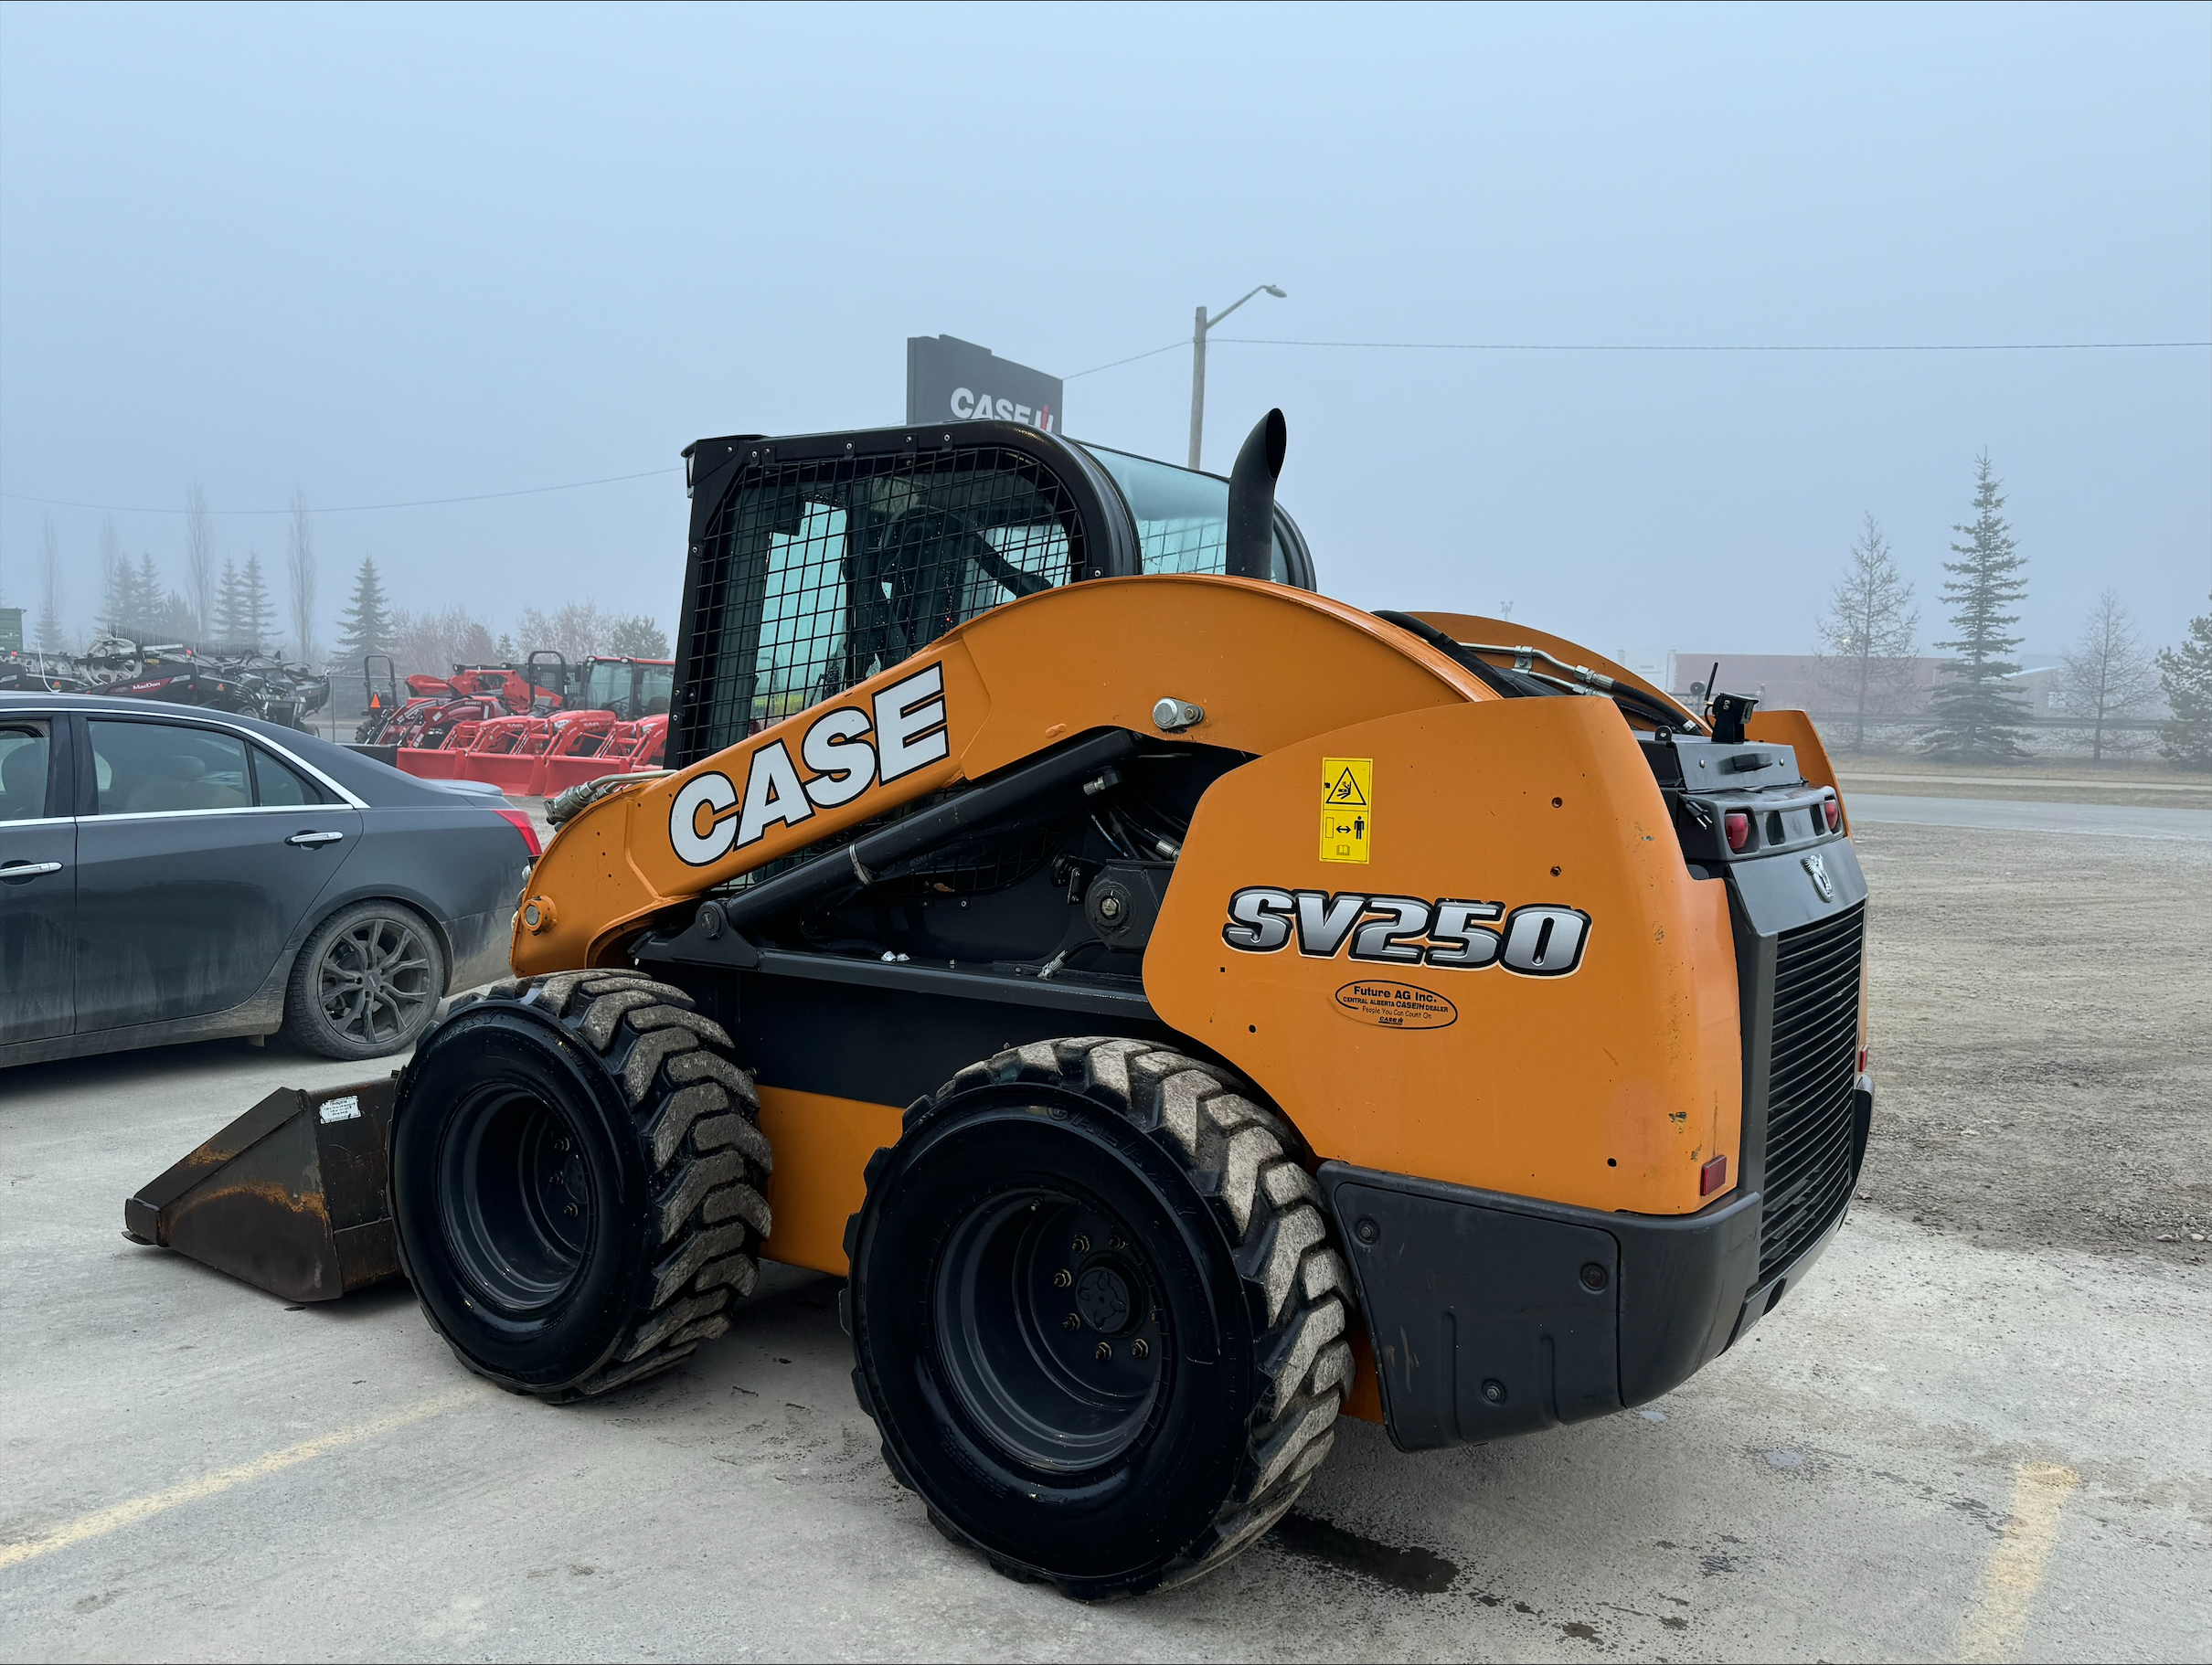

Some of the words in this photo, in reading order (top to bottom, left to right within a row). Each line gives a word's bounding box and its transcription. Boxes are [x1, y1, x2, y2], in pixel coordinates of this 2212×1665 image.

[950, 387, 1031, 426] CASE
[133, 682, 161, 690] MacDon
[668, 660, 951, 868] CASE
[1222, 885, 1592, 980] SV250
[1343, 996, 1368, 1004] CENTRAL
[1369, 999, 1395, 1007] ALBERTA
[1425, 1004, 1449, 1013] DEALER
[1354, 986, 1391, 998] Future
[1394, 990, 1411, 1001] AG
[1415, 992, 1437, 1003] Inc.
[1362, 1005, 1381, 1014] People
[1381, 1007, 1393, 1015] You
[1405, 1010, 1421, 1018] Count
[1046, 1099, 1197, 1216] GALAXY
